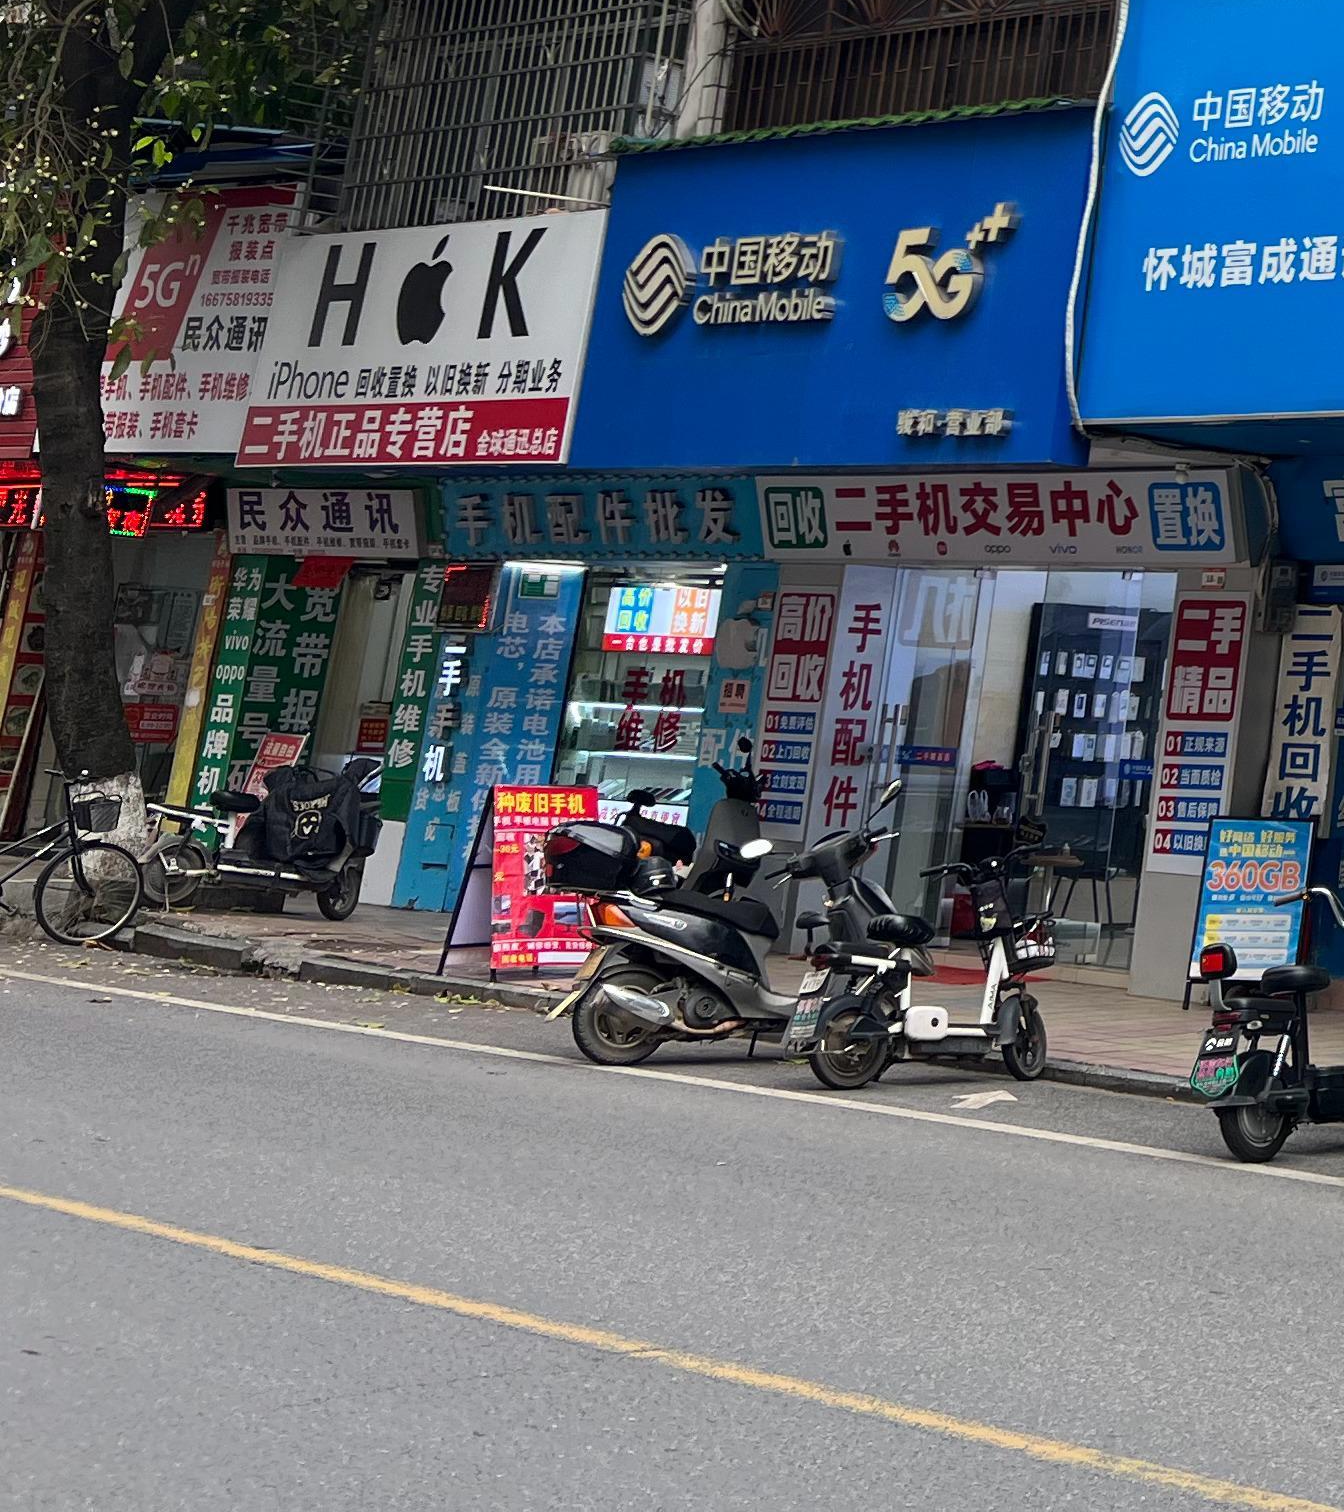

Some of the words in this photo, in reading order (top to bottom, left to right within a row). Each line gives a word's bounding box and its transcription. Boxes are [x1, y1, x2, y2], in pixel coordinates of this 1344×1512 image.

[1193, 80, 1324, 131] 中国移动
[1189, 136, 1247, 163] China
[1251, 128, 1319, 159] Mobile
[227, 214, 288, 234] 千兆宽带
[229, 241, 275, 261] 报装点
[701, 231, 838, 286] 中国移动
[211, 269, 272, 285] 宽带报装电话
[201, 292, 273, 307] 16675819335
[693, 293, 752, 325] China
[756, 290, 828, 322] Mobile
[181, 315, 268, 352] 民众通讯
[267, 361, 349, 400] iPhone
[354, 364, 418, 398] 回收置换
[425, 362, 490, 396] 以旧换新
[496, 358, 562, 394] 分期业务
[245, 404, 475, 460] 二手机正品专营店
[239, 491, 399, 535] 民众通讯
[455, 489, 743, 547] 手机配件批发
[769, 490, 827, 549] 回收
[834, 479, 1139, 538] 二手机交易中心
[1152, 486, 1223, 549] 置换
[1049, 543, 1078, 555] vivo
[233, 567, 262, 591] 华为
[226, 596, 258, 621] 荣耀
[621, 587, 653, 608] 高价
[676, 587, 709, 608] 以旧
[617, 609, 649, 631] 回收
[672, 611, 708, 634] 换新
[779, 595, 834, 642] 高价
[1177, 606, 1243, 656] 二手
[225, 630, 249, 651] vivo
[215, 664, 246, 686] oppo
[278, 586, 340, 733] 宽带报
[387, 564, 446, 769] 专业手机维修
[768, 653, 826, 701] 回收
[622, 668, 686, 706] 手机
[722, 681, 747, 699] 招聘
[1169, 663, 1235, 716] 精品
[614, 704, 683, 753] 维修
[823, 602, 882, 828] 手机配件
[1273, 609, 1334, 820] 二手机回收
[198, 694, 233, 795] 品牌机
[1183, 735, 1226, 755] 正规来源
[1179, 767, 1222, 787] 当面质检
[1172, 833, 1207, 852] 以旧换
[1206, 859, 1301, 892] 360GB
